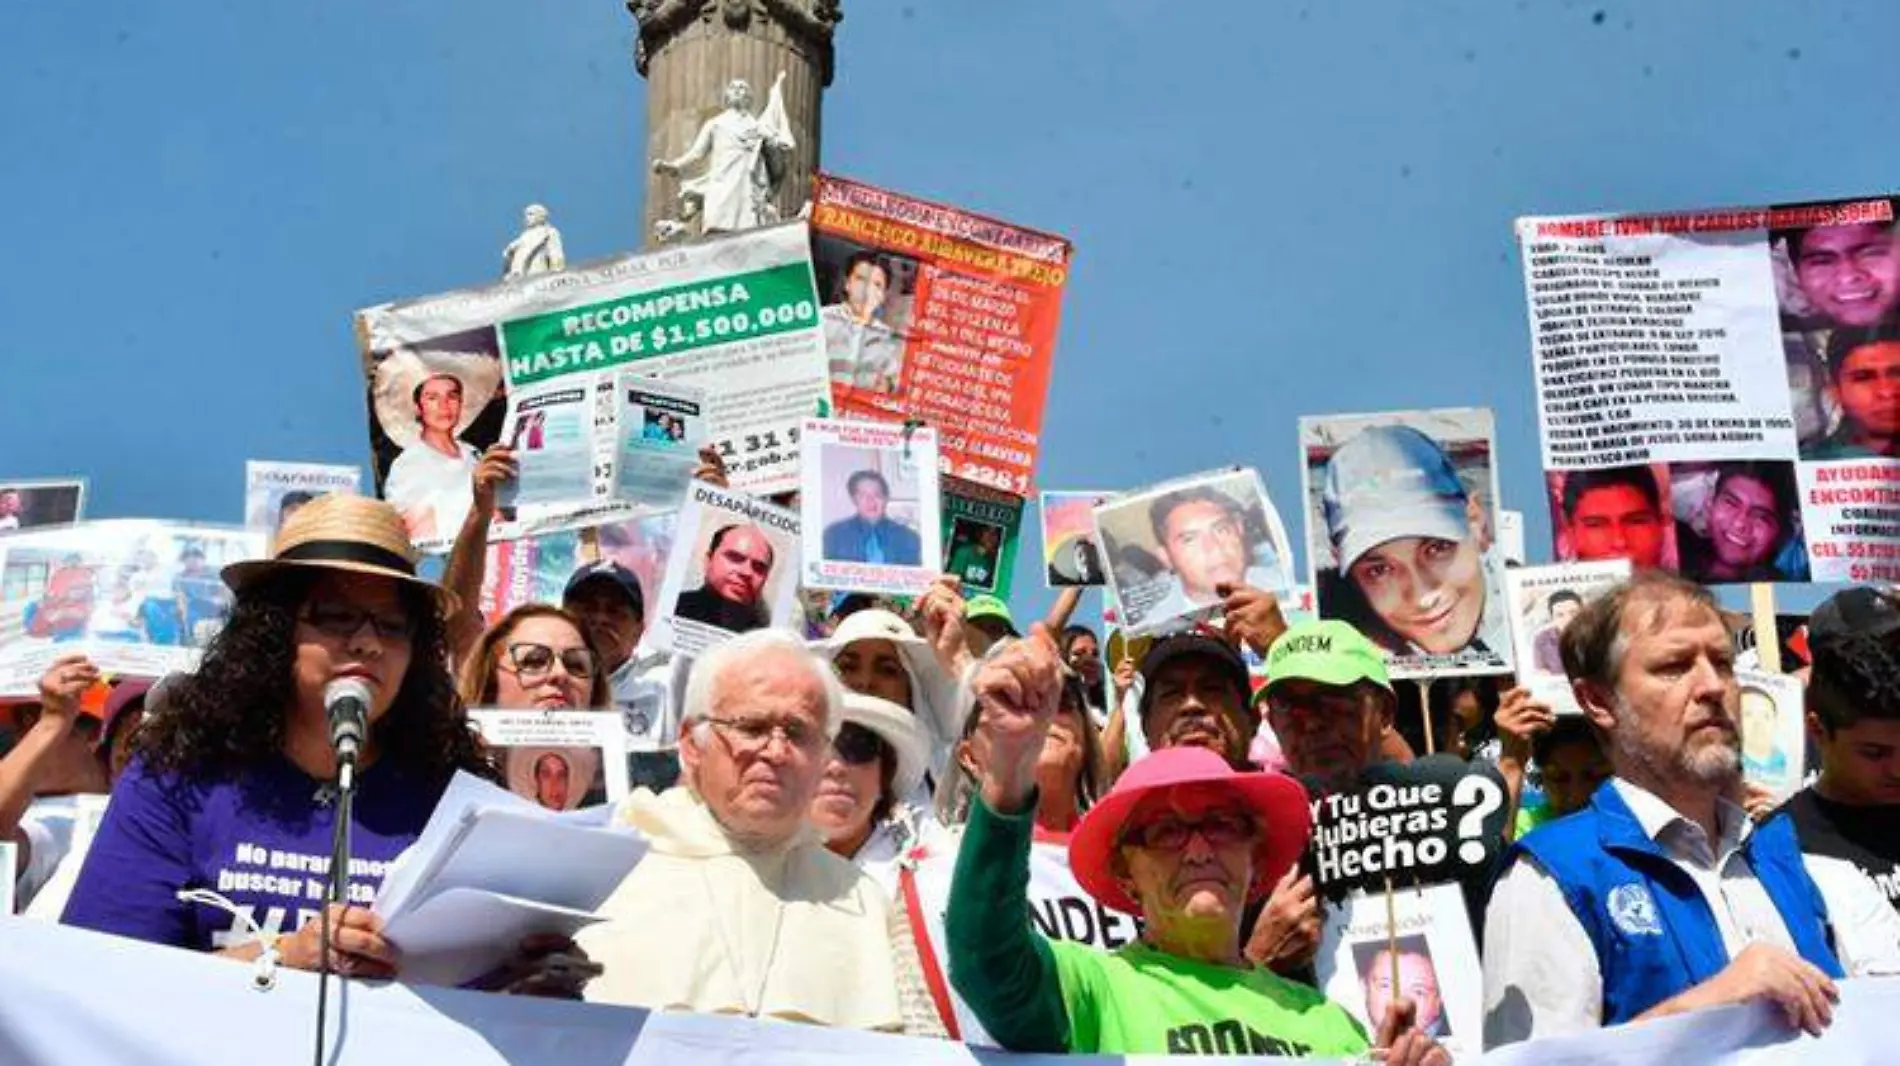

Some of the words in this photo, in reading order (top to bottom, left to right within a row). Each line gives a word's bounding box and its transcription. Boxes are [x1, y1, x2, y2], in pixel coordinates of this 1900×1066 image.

[561, 283, 750, 337] RECOMPENSA
[510, 340, 605, 378] HASTA
[610, 334, 645, 358] DE
[1326, 792, 1361, 818] Tu
[1367, 783, 1443, 810] Que
[236, 842, 267, 865] No
[1316, 835, 1448, 884] Hecho
[217, 869, 302, 898] buscar
